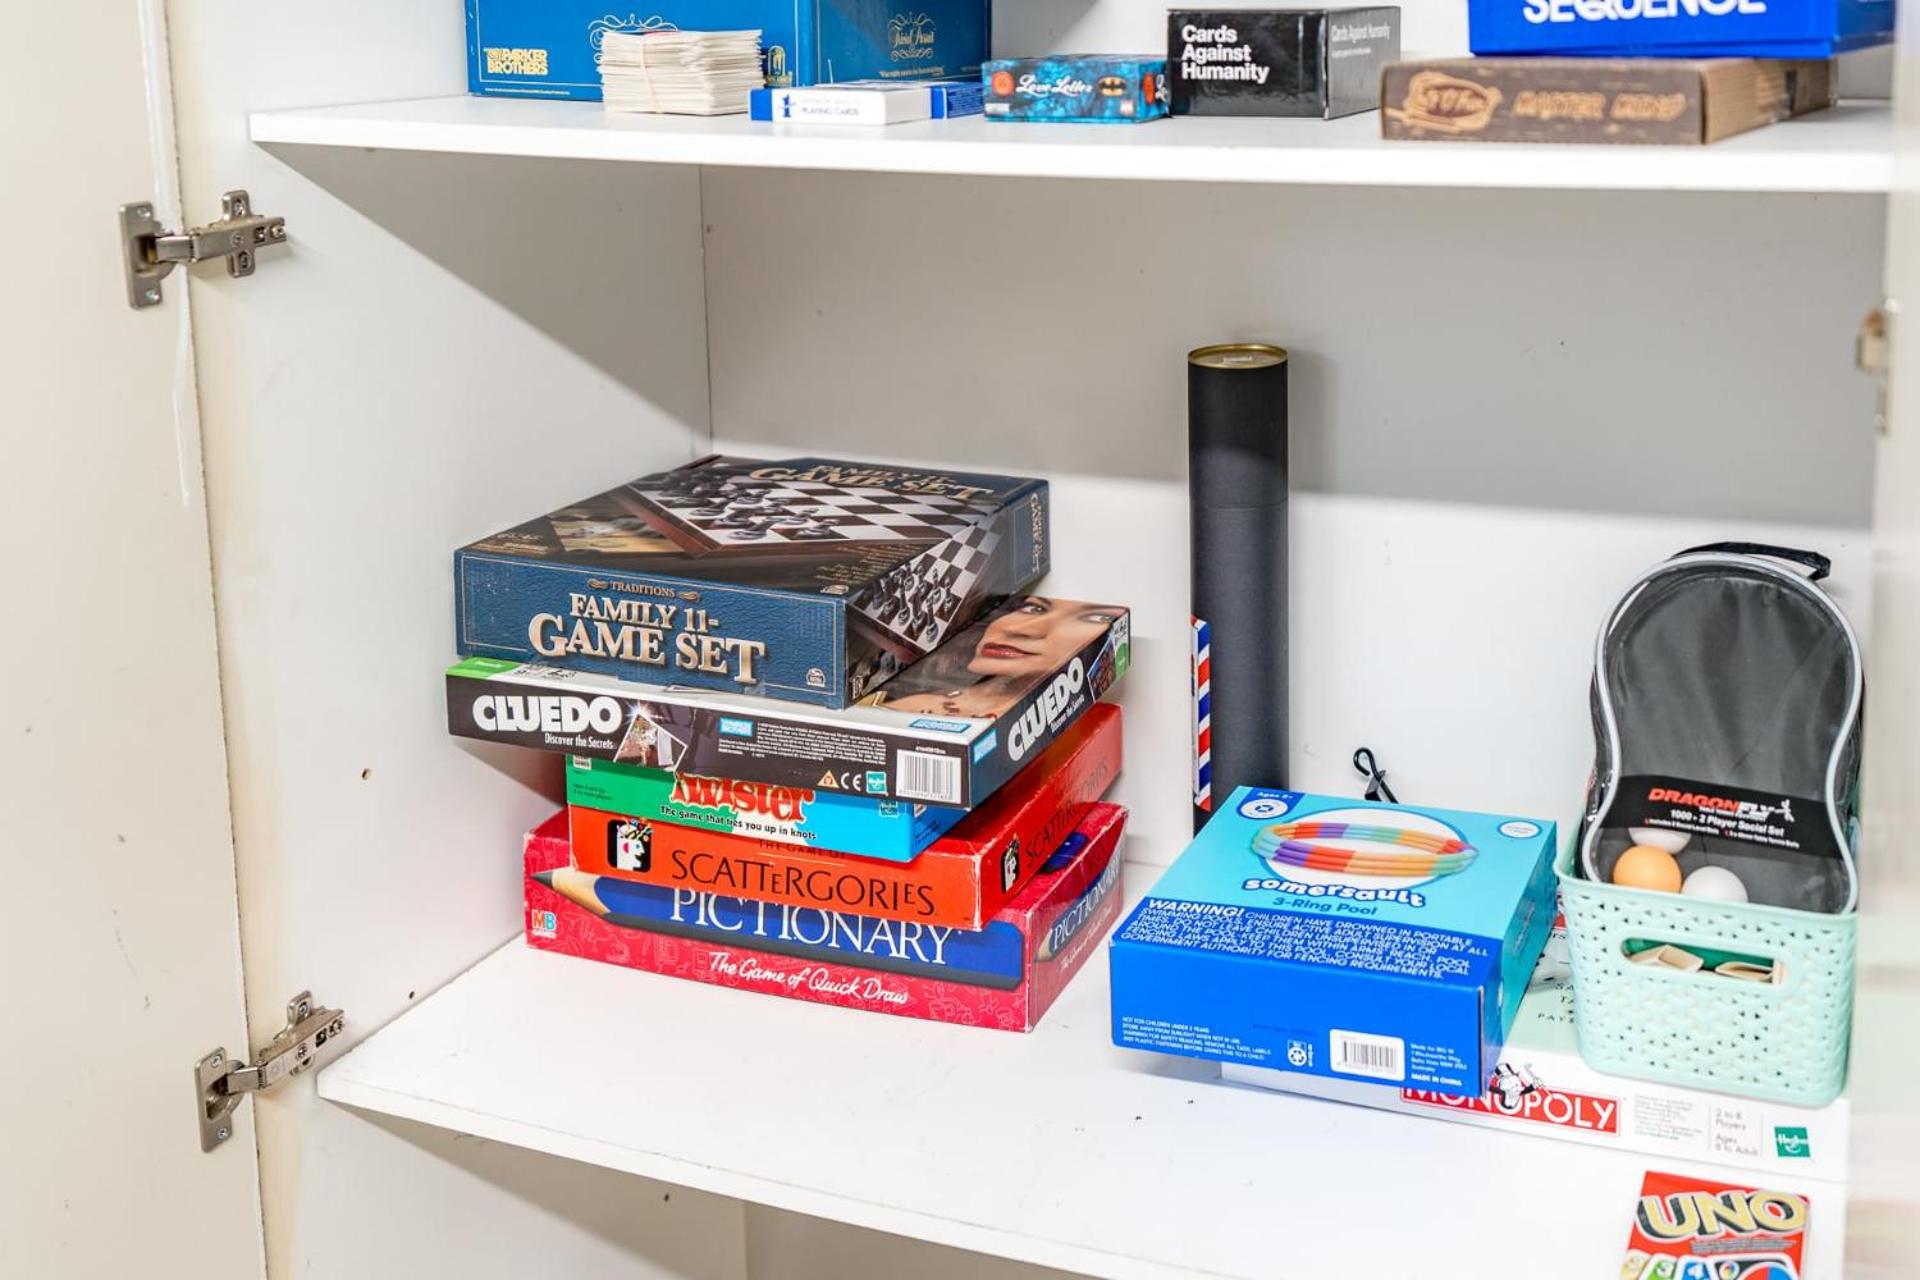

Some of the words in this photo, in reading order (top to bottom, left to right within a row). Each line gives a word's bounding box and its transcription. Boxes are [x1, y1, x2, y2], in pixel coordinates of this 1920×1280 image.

[1181, 25, 1238, 43] Cards
[487, 60, 549, 75] BROTHERS
[502, 48, 548, 62] PARKER
[1181, 44, 1253, 64] Against
[1015, 74, 1051, 98] Love
[1051, 75, 1093, 97] Letter
[1181, 62, 1270, 85] Humanity
[610, 581, 676, 598] TRADITIONS
[569, 592, 678, 630] FAMILY
[683, 607, 720, 633] 11-
[528, 612, 666, 667] GAME
[675, 632, 766, 684] SET
[472, 694, 622, 734] CLUEDO
[1008, 656, 1084, 762] CLUEDO
[544, 732, 573, 746] Discover
[575, 734, 587, 747] the
[679, 810, 702, 821] game
[706, 812, 724, 824] that
[726, 816, 743, 828] ties
[745, 821, 762, 831] you
[764, 824, 776, 835] up
[778, 826, 788, 836] in
[790, 827, 817, 841] knots
[1706, 813, 1737, 829] Player
[1737, 820, 1767, 833] Social
[1767, 826, 1785, 837] Set
[672, 848, 937, 916] SCATTERGORIES
[1243, 876, 1428, 909] somersault
[1273, 897, 1335, 913] 3-Ring
[1338, 902, 1378, 916] Pool
[670, 886, 953, 965] PICTIONARY
[1149, 899, 1245, 917] WARNING!
[1244, 912, 1302, 924] CHILDREN
[1304, 918, 1333, 927] HAVE
[1335, 921, 1397, 934] DROWNED
[1413, 930, 1473, 946] PORTABLE
[1121, 932, 1199, 948] GOVERNMENT
[1266, 950, 1293, 960] FOR
[1293, 953, 1347, 967] FENCING
[1468, 946, 1488, 957] ALL
[709, 951, 737, 976] The
[739, 958, 786, 983] Game
[787, 967, 811, 989] of
[808, 967, 863, 999] Quick
[863, 977, 909, 1004] Draw
[1411, 1073, 1430, 1081] MADE
[1440, 1076, 1462, 1086] CHINA
[1637, 1190, 1809, 1239] UNO
